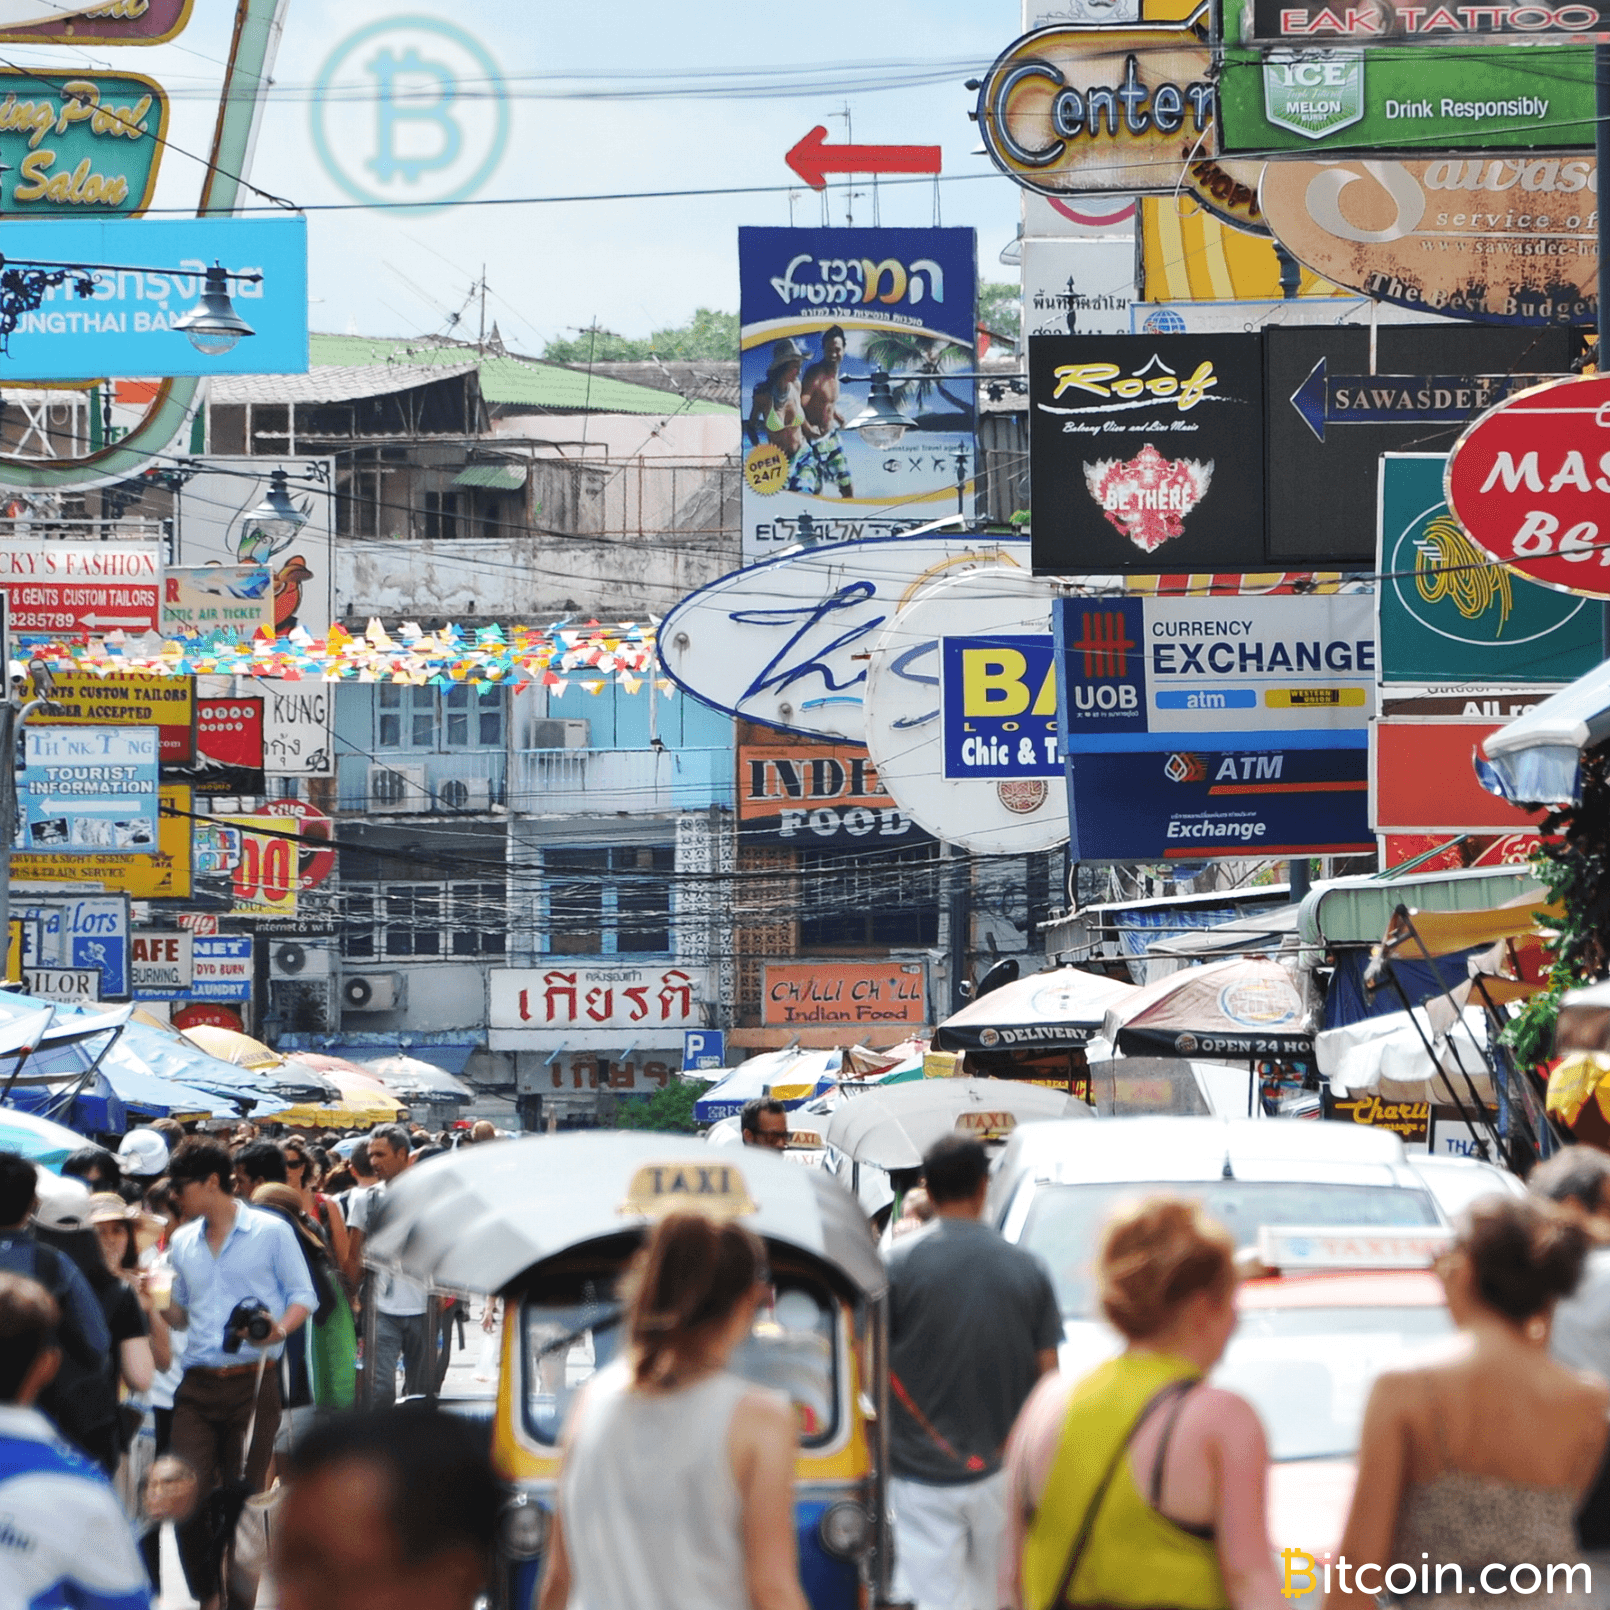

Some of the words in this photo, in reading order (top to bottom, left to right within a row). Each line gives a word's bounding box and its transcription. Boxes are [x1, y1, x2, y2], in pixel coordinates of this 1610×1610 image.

[1396, 5, 1600, 33] TATTOO
[1283, 63, 1346, 86] ICE
[994, 54, 1214, 167] Center
[1287, 101, 1341, 113] MELON
[1386, 99, 1434, 119] Drink
[1440, 96, 1549, 121] Responsibly
[14, 150, 129, 206] Salon
[1436, 209, 1550, 229] service
[1335, 388, 1492, 410] SAWASDEE
[749, 456, 781, 473] OPEN
[752, 467, 783, 485] 24/7
[65, 552, 155, 577] FASHION
[22, 588, 59, 606] GENTS
[63, 588, 107, 606] CUSTOM
[109, 589, 155, 607] TAILORS
[198, 608, 218, 620] AIR
[222, 607, 262, 619] TICKET
[1152, 620, 1253, 637] CURRENCY
[1153, 640, 1375, 674] EXCHANGE
[79, 686, 129, 700] CUSTOM
[134, 688, 188, 701] TAILORS
[1075, 685, 1138, 710] UOB
[1186, 691, 1226, 709] atm
[87, 706, 153, 719] ACCEPTED
[273, 695, 325, 724] KUNG
[1462, 701, 1500, 717] All
[962, 736, 1009, 766] Chic
[1018, 737, 1036, 764] &
[45, 766, 138, 781] TOURIST
[1215, 755, 1284, 780] ATM
[29, 781, 153, 795] INFORMATION
[747, 758, 893, 800] INDI
[779, 807, 912, 837] FOOD
[1167, 820, 1266, 840] Exchange
[133, 938, 179, 962] AFE
[193, 942, 243, 955] NET
[191, 983, 245, 996] LAUNDRY
[784, 1005, 851, 1022] Indian
[855, 1005, 908, 1021] Food
[1000, 1027, 1088, 1043] DELIVERY
[687, 1034, 705, 1061] P
[1202, 1039, 1250, 1052] OPEN
[1256, 1039, 1279, 1053] 24
[964, 1113, 1009, 1129] TAXI
[790, 1133, 817, 1144] AXI
[646, 1167, 732, 1195] TAXI
